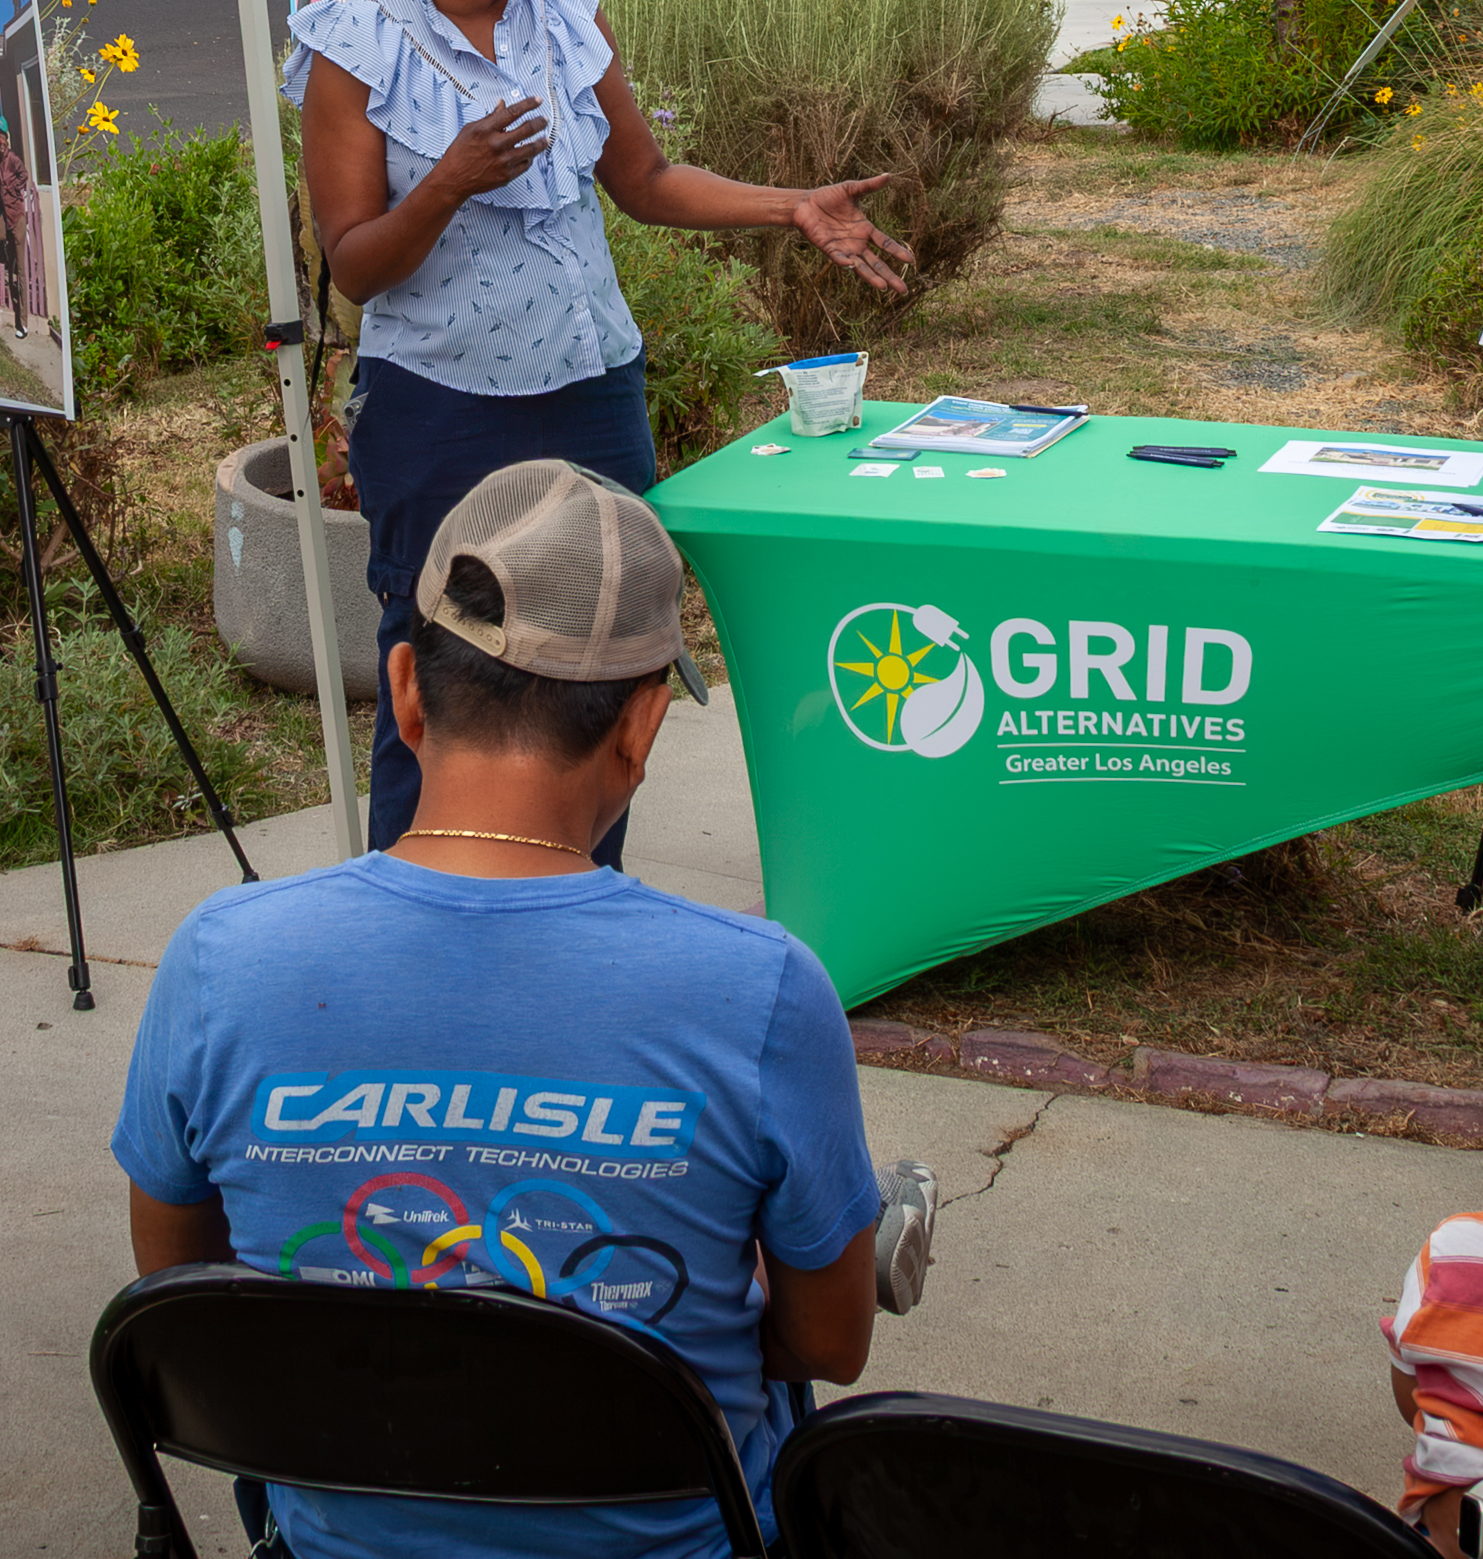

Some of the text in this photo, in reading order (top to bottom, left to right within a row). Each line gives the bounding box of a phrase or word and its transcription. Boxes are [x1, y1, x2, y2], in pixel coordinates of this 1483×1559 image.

[989, 617, 1254, 706] GRID
[996, 710, 1246, 742] ALTERNATIVES
[1005, 752, 1233, 778] Greater Los Angeles
[263, 1082, 687, 1146] CARLISLE
[245, 1144, 690, 1179] INTERCONNECT TECHNOLOGIES
[402, 1209, 450, 1225] UniTrek
[534, 1217, 594, 1231] TRI-STAR
[590, 1280, 654, 1303] Thermax
